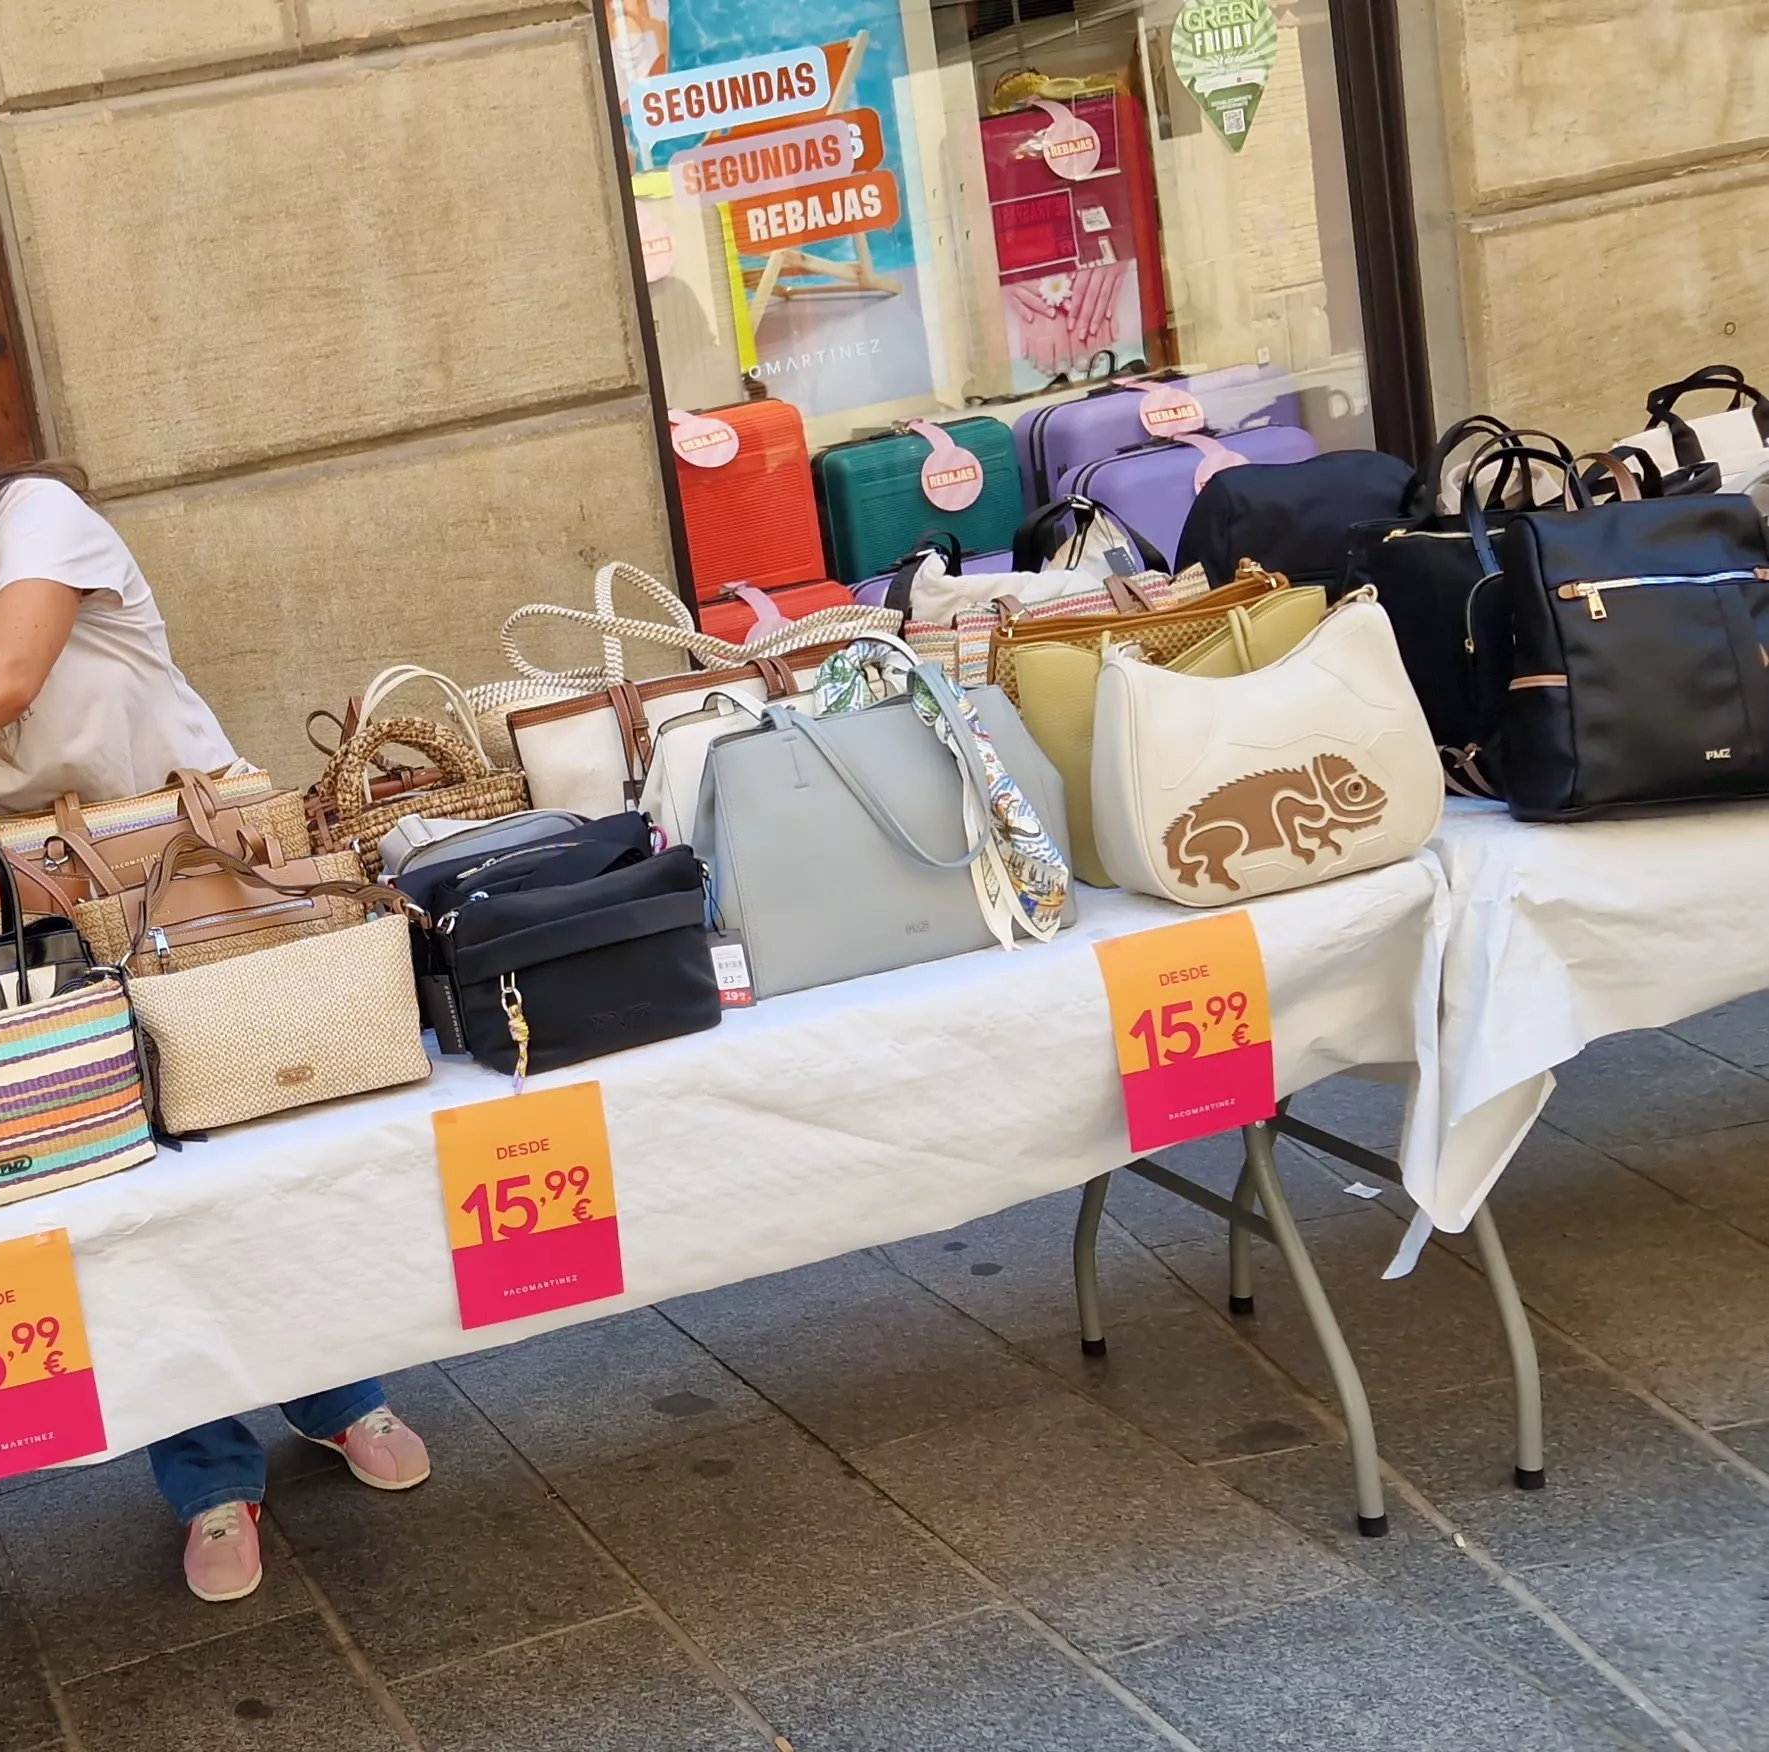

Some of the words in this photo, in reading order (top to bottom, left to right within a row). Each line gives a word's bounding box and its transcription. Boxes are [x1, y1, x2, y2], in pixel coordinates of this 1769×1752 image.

[1182, 0, 1259, 33] GREEN
[1194, 23, 1252, 55] FRIDAY
[643, 62, 817, 127] SEGUNDAS
[1049, 138, 1094, 158] REBAJAS
[682, 134, 842, 196] SEGUNDAS
[746, 184, 882, 243] REBAJAS
[643, 240, 669, 254] AJAS
[744, 338, 881, 381] OMARTINEZ
[1148, 405, 1196, 422] REBAJAS
[928, 467, 975, 488] REBAJAS
[1704, 748, 1732, 760] PMZ
[111, 852, 161, 871] PACOMARTINE
[1159, 965, 1210, 986] DESDE
[1129, 991, 1248, 1068] 15,99
[1232, 1023, 1251, 1047] €
[1168, 1098, 1236, 1120] PACOMARTINEZ
[496, 1138, 551, 1160] DESDE
[461, 1165, 589, 1244] 15,99
[572, 1198, 593, 1222] €
[503, 1274, 578, 1297] PACOMARTINEZ
[43, 1350, 67, 1376] €
